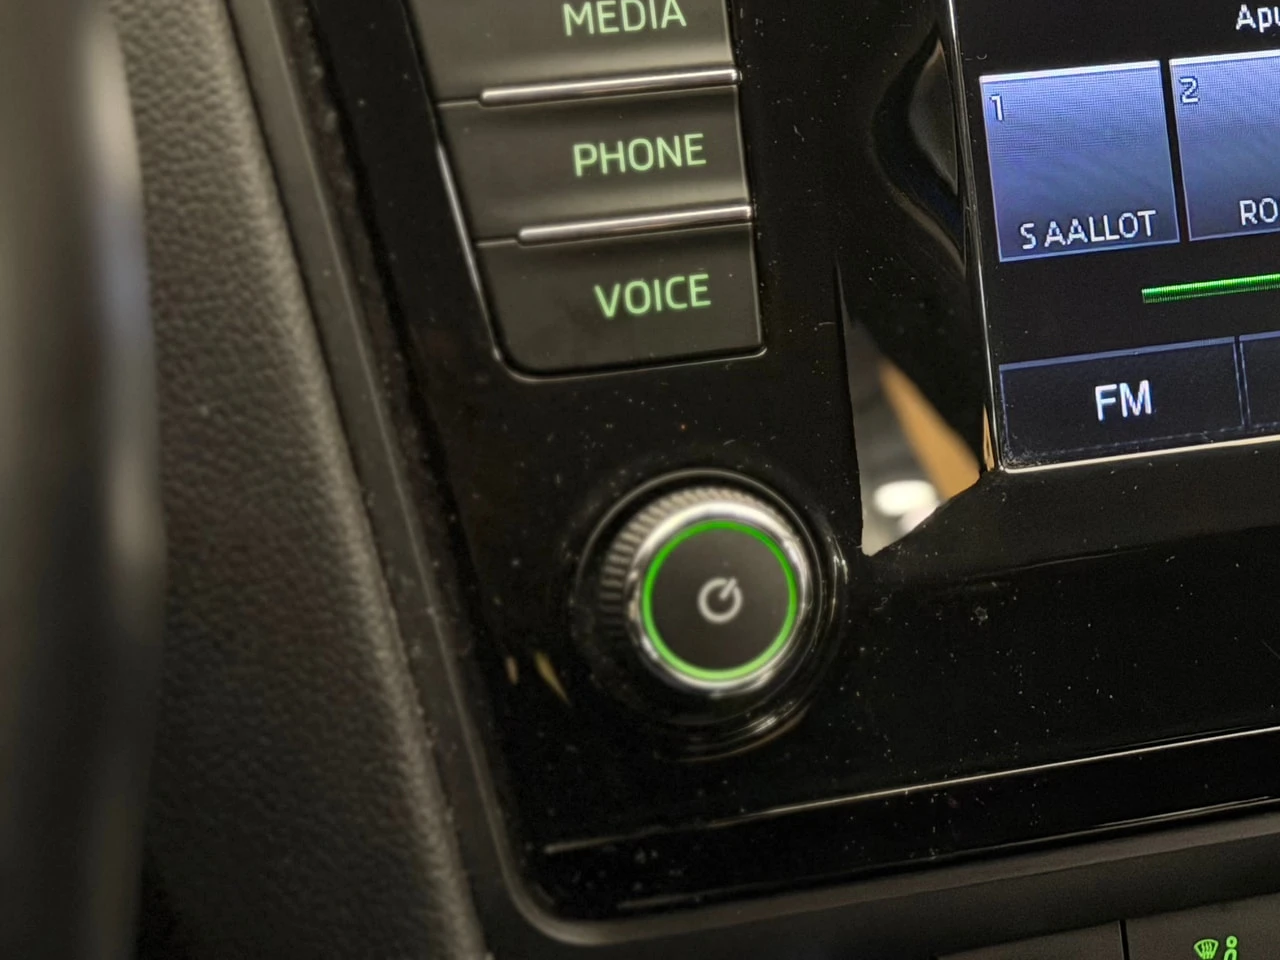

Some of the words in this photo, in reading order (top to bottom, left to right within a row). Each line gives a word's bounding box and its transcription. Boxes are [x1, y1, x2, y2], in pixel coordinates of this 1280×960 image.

[989, 93, 1004, 122] 1
[1178, 76, 1201, 106] 2
[572, 133, 708, 178] PHONE
[594, 273, 712, 319] VOICE
[1094, 379, 1153, 421] FM
